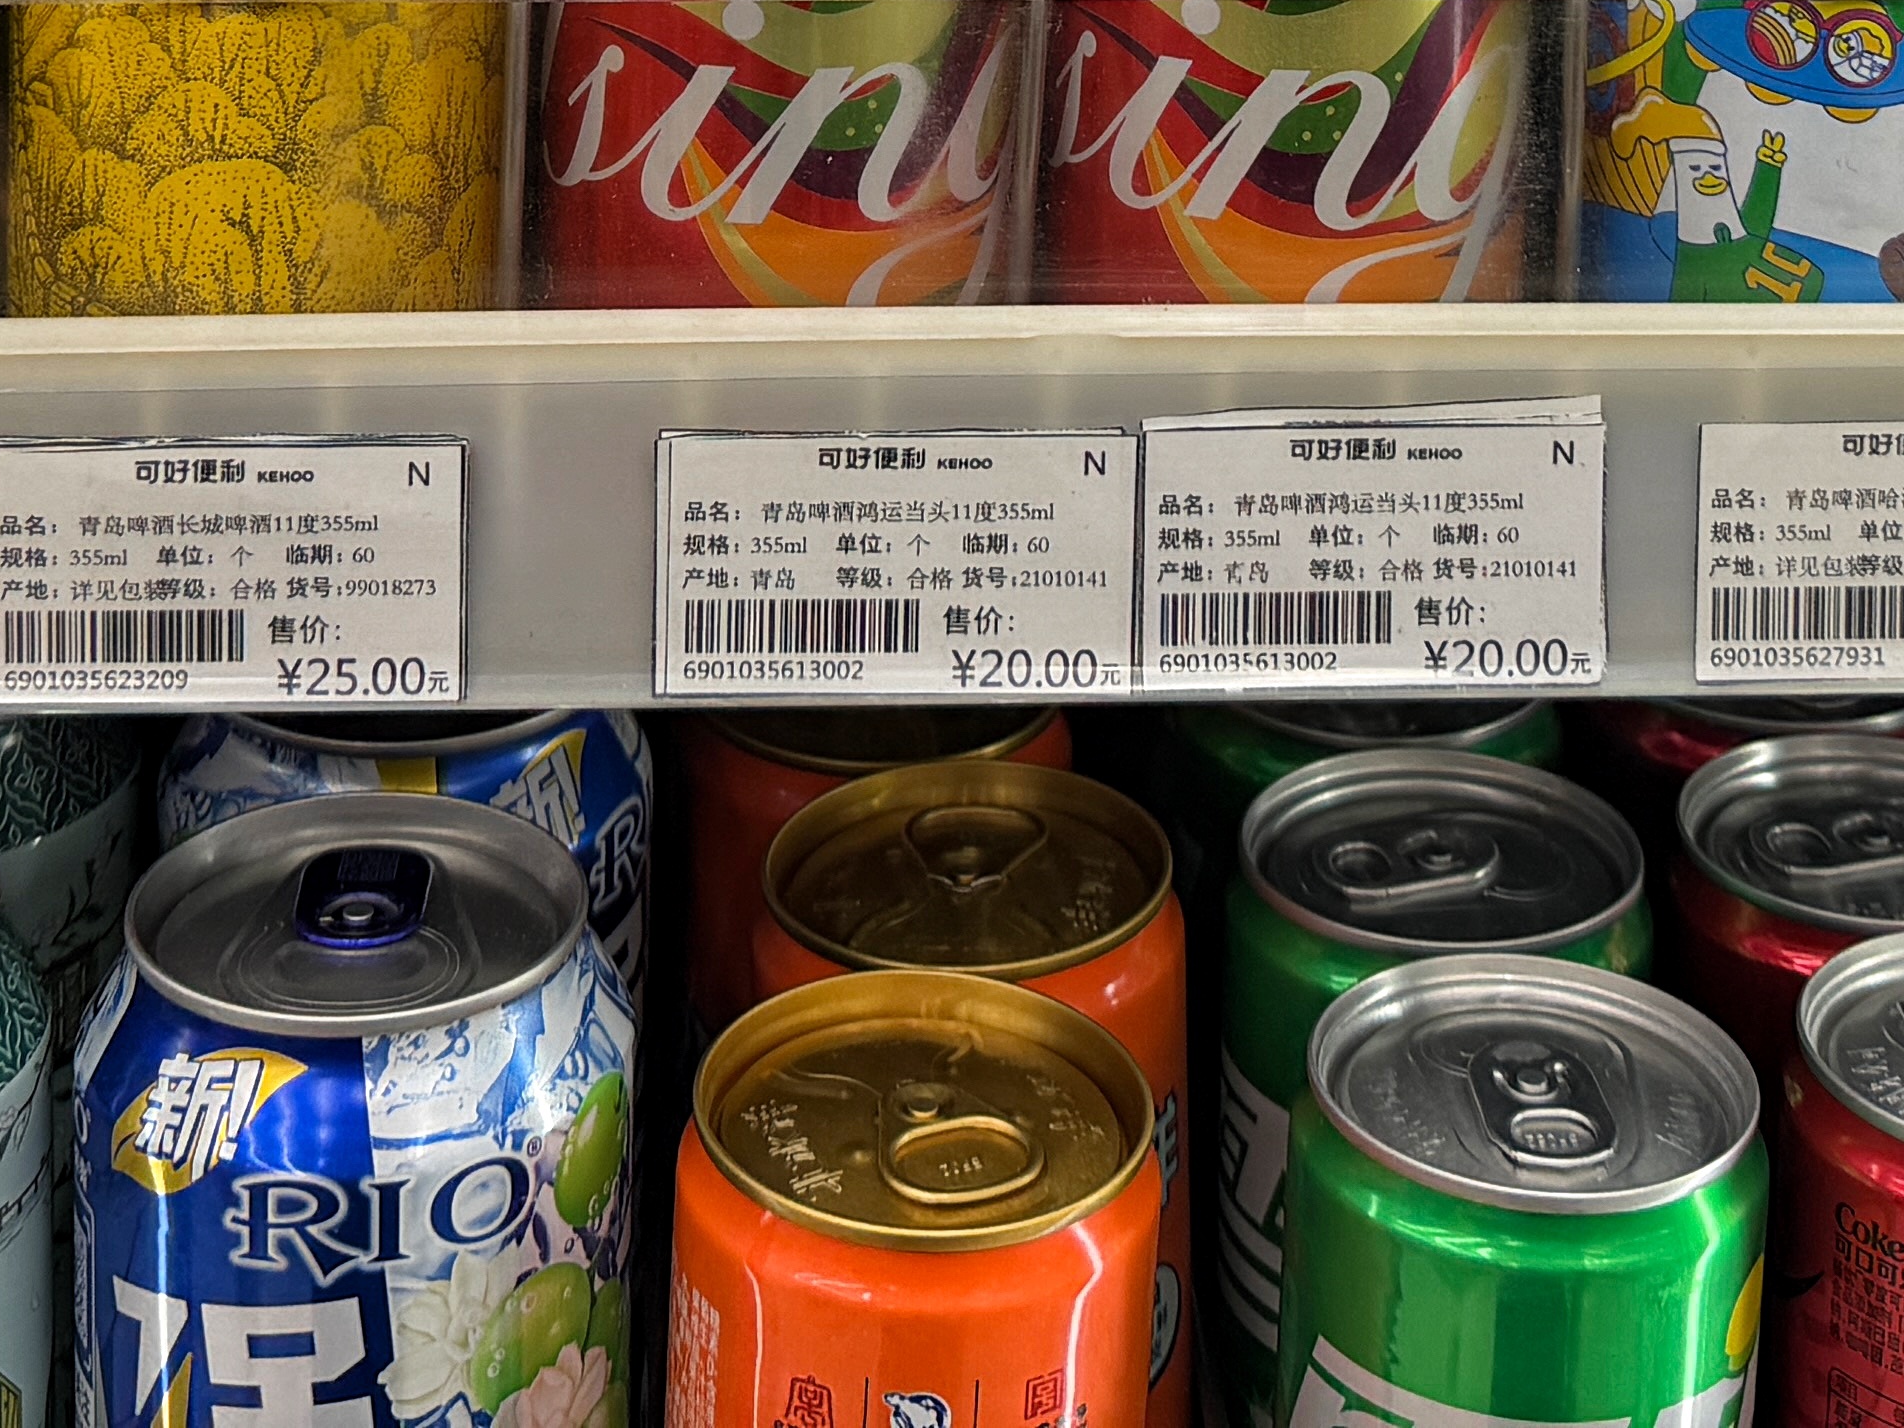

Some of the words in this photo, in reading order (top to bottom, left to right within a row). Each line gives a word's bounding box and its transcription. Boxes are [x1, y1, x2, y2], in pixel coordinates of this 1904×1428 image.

[1289, 437, 1396, 462] 可好便利
[134, 458, 246, 485] 可好便利
[951, 648, 1122, 689] ¥20.00元
[1423, 637, 1592, 678] ¥20.00元
[1709, 645, 1885, 667] 6901035627931
[4, 668, 189, 691] 6901035623209
[277, 656, 450, 697] ¥25.00元
[232, 1144, 537, 1272] RIO
